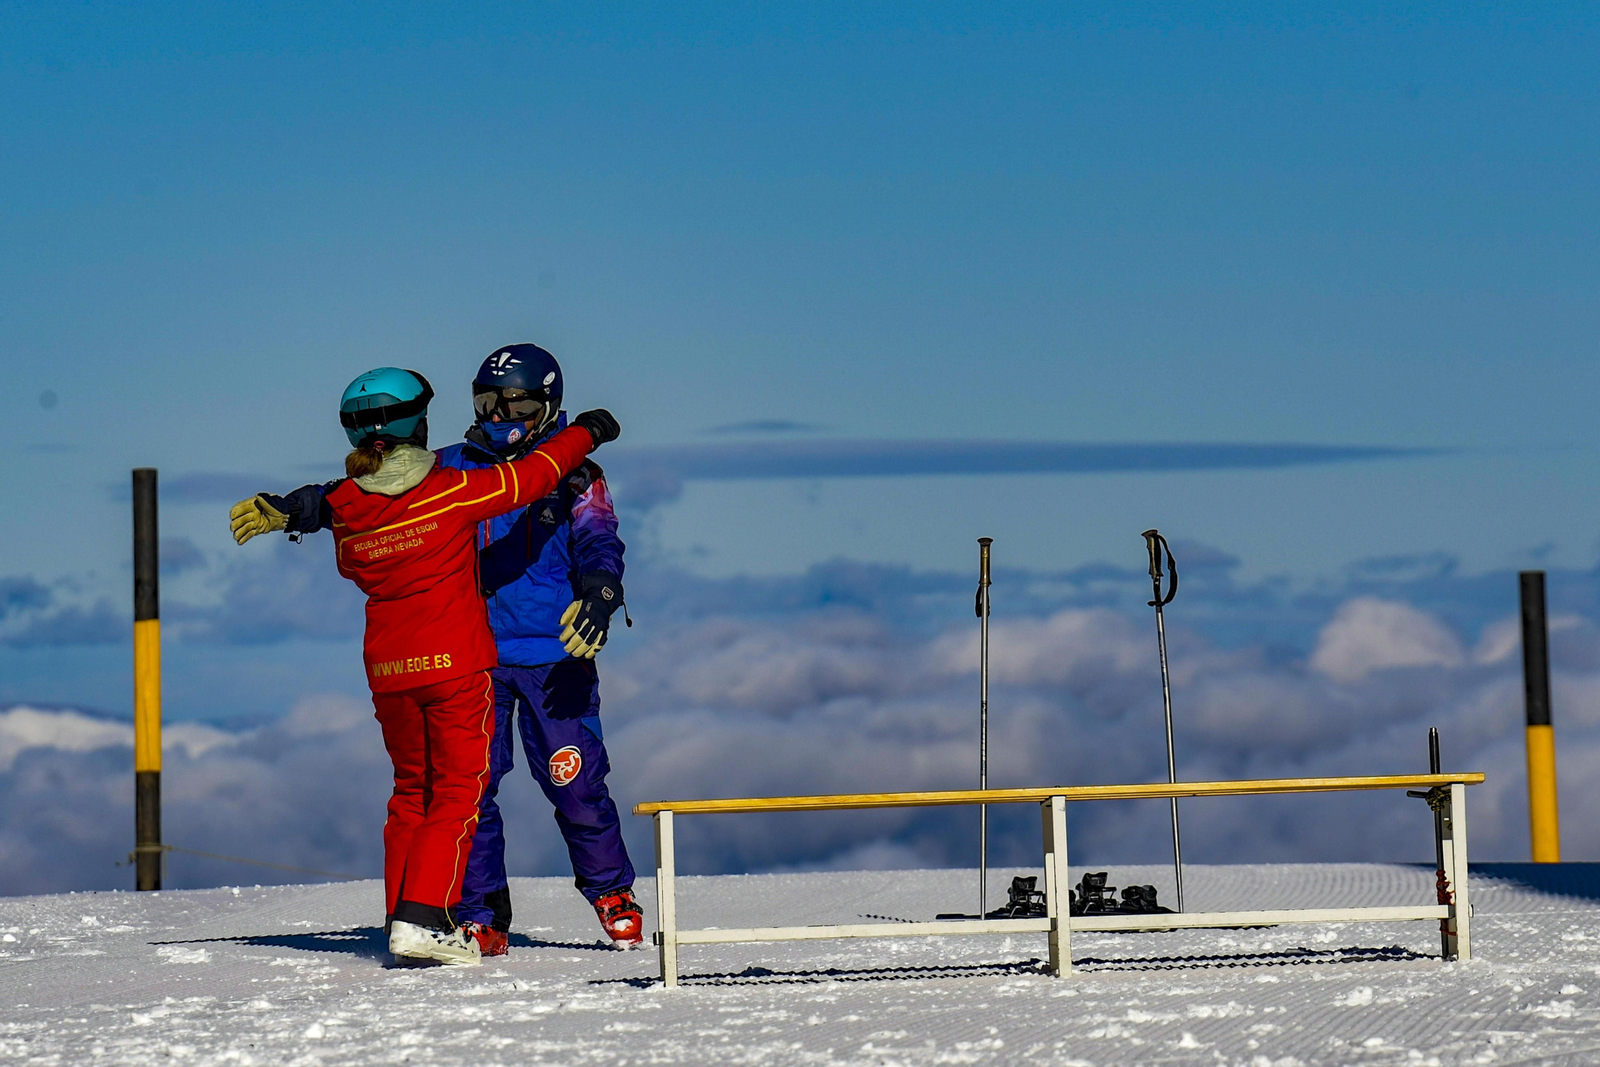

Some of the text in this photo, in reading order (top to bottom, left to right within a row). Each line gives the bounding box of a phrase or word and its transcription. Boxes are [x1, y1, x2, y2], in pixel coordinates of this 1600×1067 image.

[354, 521, 439, 552] ESCUELA OFICIAL DE ESQUI
[368, 537, 424, 559] SIERRA NEVADA
[372, 653, 452, 677] WWW.EOE.ES
